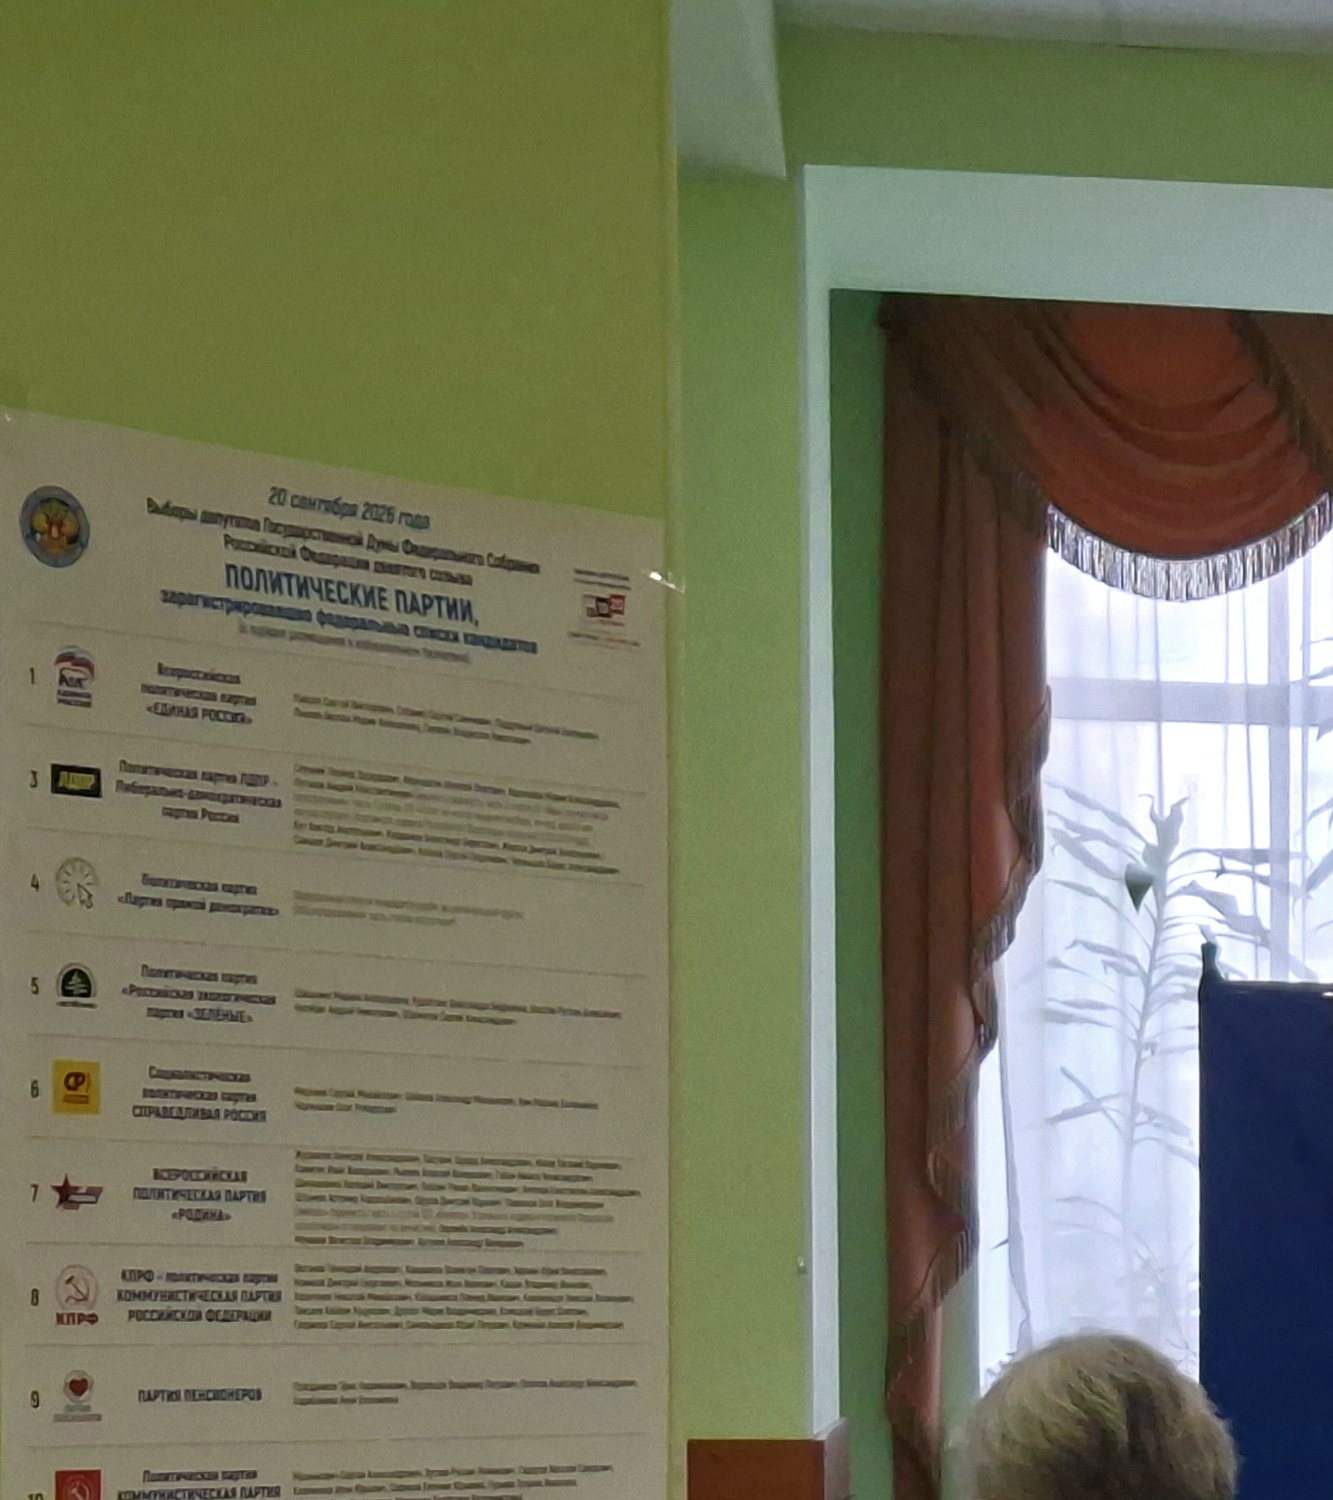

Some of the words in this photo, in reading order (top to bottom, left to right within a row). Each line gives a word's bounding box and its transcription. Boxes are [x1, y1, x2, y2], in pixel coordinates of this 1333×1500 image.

[224, 563, 388, 611] ПОЛИТИЧЕСКИЕ
[395, 588, 479, 629] ПАРТИИ,
[30, 873, 40, 893] 4
[30, 977, 40, 996] 5
[30, 1390, 40, 1409] 9
